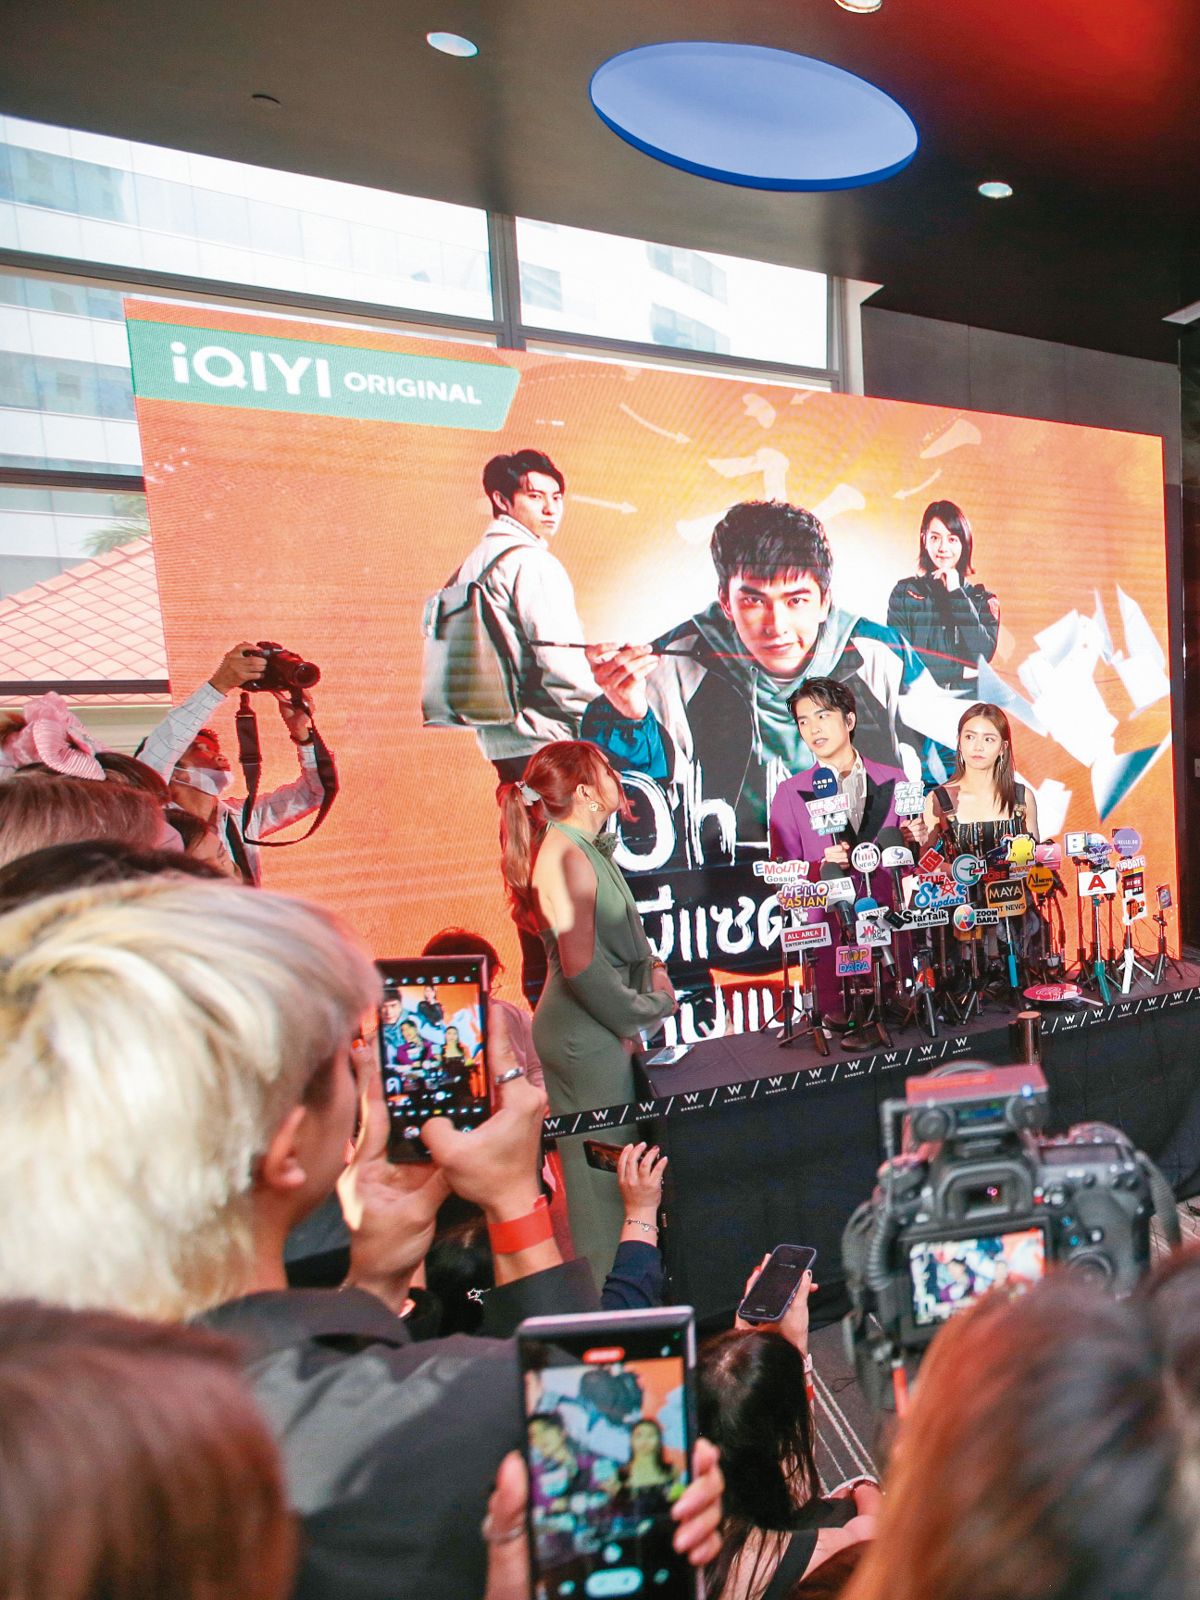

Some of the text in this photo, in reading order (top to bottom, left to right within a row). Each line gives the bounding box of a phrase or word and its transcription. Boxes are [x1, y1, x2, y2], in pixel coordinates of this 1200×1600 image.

[169, 341, 482, 405] iQIYI ORIGINAL
[1043, 847, 1054, 860] Z
[766, 875, 796, 883] Gossip
[1087, 874, 1107, 891] A
[783, 882, 829, 898] HELLO
[989, 886, 1023, 899] MAYA
[786, 895, 827, 908] ASIAN
[930, 896, 966, 911] update
[1005, 902, 1026, 911] NEWS
[902, 909, 947, 923] StarTalk
[787, 930, 820, 940] ALL AREA
[785, 937, 827, 948] ENTERTAINMENT
[839, 948, 869, 962] TOP
[839, 962, 869, 973] DARA
[544, 1118, 560, 1130] W
[592, 1109, 609, 1121] W
[640, 1101, 655, 1112] W
[684, 1092, 699, 1104] W
[728, 1083, 742, 1095] W
[769, 1076, 783, 1087] W
[808, 1068, 822, 1079] W
[847, 1060, 860, 1070] W
[885, 1052, 898, 1063] W
[920, 1044, 933, 1055] W
[955, 1036, 968, 1047] W
[1065, 1014, 1075, 1024] W
[1093, 1009, 1103, 1018] W
[1121, 1003, 1130, 1011] W
[1147, 997, 1157, 1006] W
[588, 1121, 614, 1129] BANGKOK
[680, 1104, 704, 1112] BANGKOK
